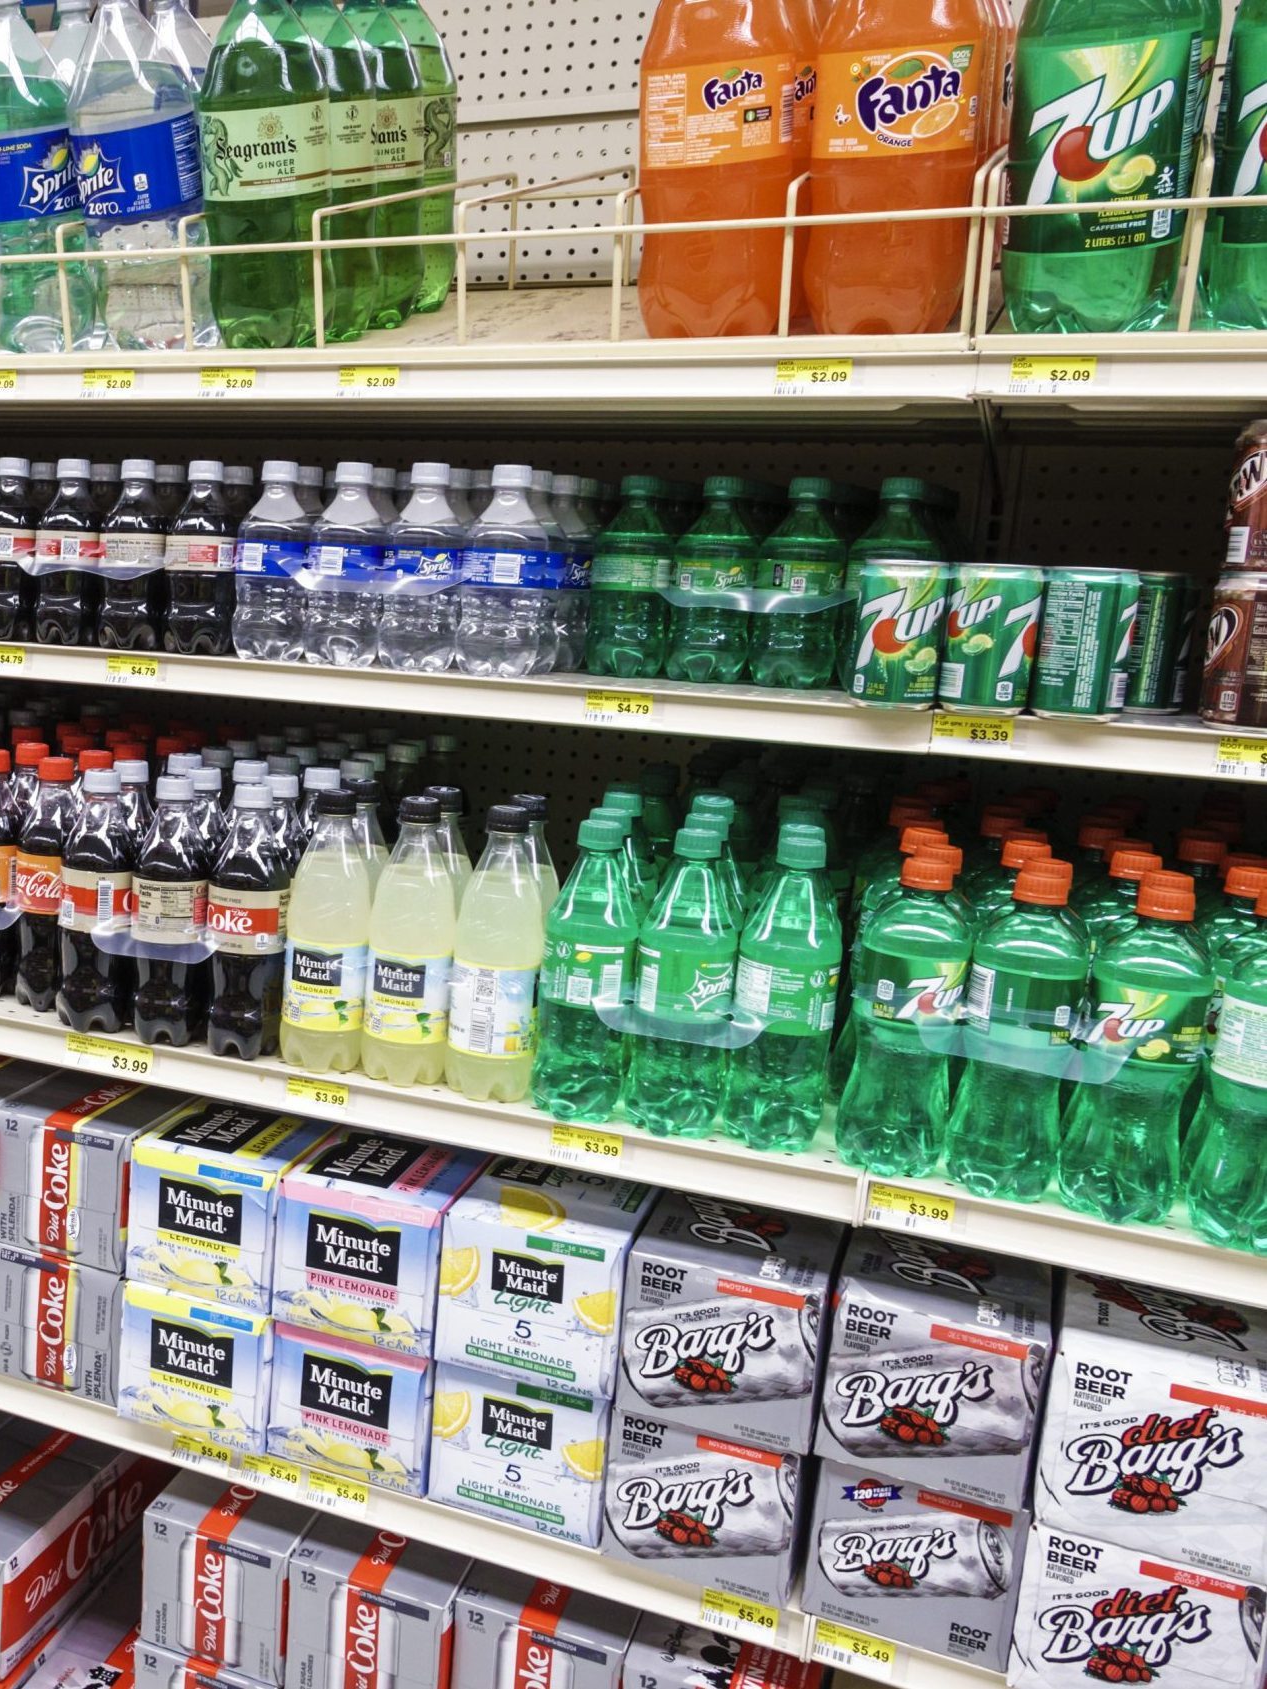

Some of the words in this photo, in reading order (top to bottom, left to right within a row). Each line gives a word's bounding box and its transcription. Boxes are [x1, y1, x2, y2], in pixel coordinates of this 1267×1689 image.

[703, 69, 764, 110] Fanta
[856, 64, 962, 134] Fanta
[216, 132, 298, 163] Seagram's
[876, 133, 913, 148] ORANGE
[257, 160, 295, 172] GINGER
[277, 166, 295, 176] ALE
[88, 201, 120, 216] zero
[1090, 222, 1128, 232] CAFFEINE
[1129, 221, 1147, 229] FREE
[1085, 238, 1091, 248] 2
[1092, 238, 1115, 247] LITERS
[107, 380, 131, 389] $2.09
[226, 378, 253, 389] $2.09
[366, 377, 395, 388] $2.09
[811, 370, 847, 383] $2.09
[1050, 369, 1090, 382] $2.09
[0, 655, 23, 665] $4.79
[617, 702, 649, 714] $4.79
[970, 728, 1008, 742] $3.39
[376, 965, 420, 984] Minute
[381, 977, 413, 993] Maid
[376, 995, 416, 1006] LEMONADE
[112, 1056, 148, 1073] $3.99
[315, 1092, 344, 1106] $3.99
[5, 1118, 18, 1131] 12
[584, 1141, 619, 1157] $3.99
[44, 1142, 70, 1213] Coke
[166, 1186, 235, 1219] Minute
[909, 1203, 949, 1222] $3.99
[47, 1213, 60, 1245] Diet
[315, 1224, 392, 1257] Minute
[498, 1258, 559, 1284] Minute
[641, 1262, 688, 1281] ROOT
[309, 1272, 336, 1287] PINK
[337, 1280, 397, 1301] LEMONADE
[640, 1275, 682, 1294] BEER
[640, 1287, 678, 1300] ARTIFICIALLY
[494, 1287, 555, 1316] Light
[639, 1296, 665, 1307] FLAVORED
[847, 1303, 898, 1325] ROOT
[513, 1319, 532, 1340] 5
[845, 1318, 891, 1340] BEER
[373, 1334, 385, 1344] 12
[387, 1338, 419, 1355] CANS
[470, 1335, 509, 1355] LIGHT
[512, 1346, 573, 1369] LEMONADE
[634, 1313, 776, 1378] Barq's
[882, 1358, 904, 1370] IT'S
[906, 1354, 934, 1367] GOOD
[1075, 1362, 1133, 1385] ROOT
[546, 1378, 560, 1391] 12
[561, 1381, 594, 1399] CANS
[837, 1361, 994, 1428] Barq's
[1074, 1376, 1126, 1400] BEER
[1079, 1421, 1105, 1431] IT'S
[1107, 1417, 1139, 1430] GOOD
[1121, 1407, 1218, 1446] diet
[201, 1446, 228, 1461] $5.49
[1066, 1423, 1245, 1495] Barq's
[269, 1468, 297, 1483] $5.49
[853, 1488, 873, 1500] 120
[153, 1521, 168, 1535] 12
[25, 1559, 63, 1613] Diet
[65, 1480, 143, 1581] Coke
[834, 1528, 957, 1583] Barq's
[301, 1571, 316, 1586] 12
[195, 1554, 224, 1623] Coke
[1092, 1585, 1188, 1621] diet
[737, 1609, 774, 1629] $5.49
[204, 1620, 218, 1656] Diet
[1038, 1601, 1213, 1668] Barq's
[853, 1642, 889, 1663] $5.49
